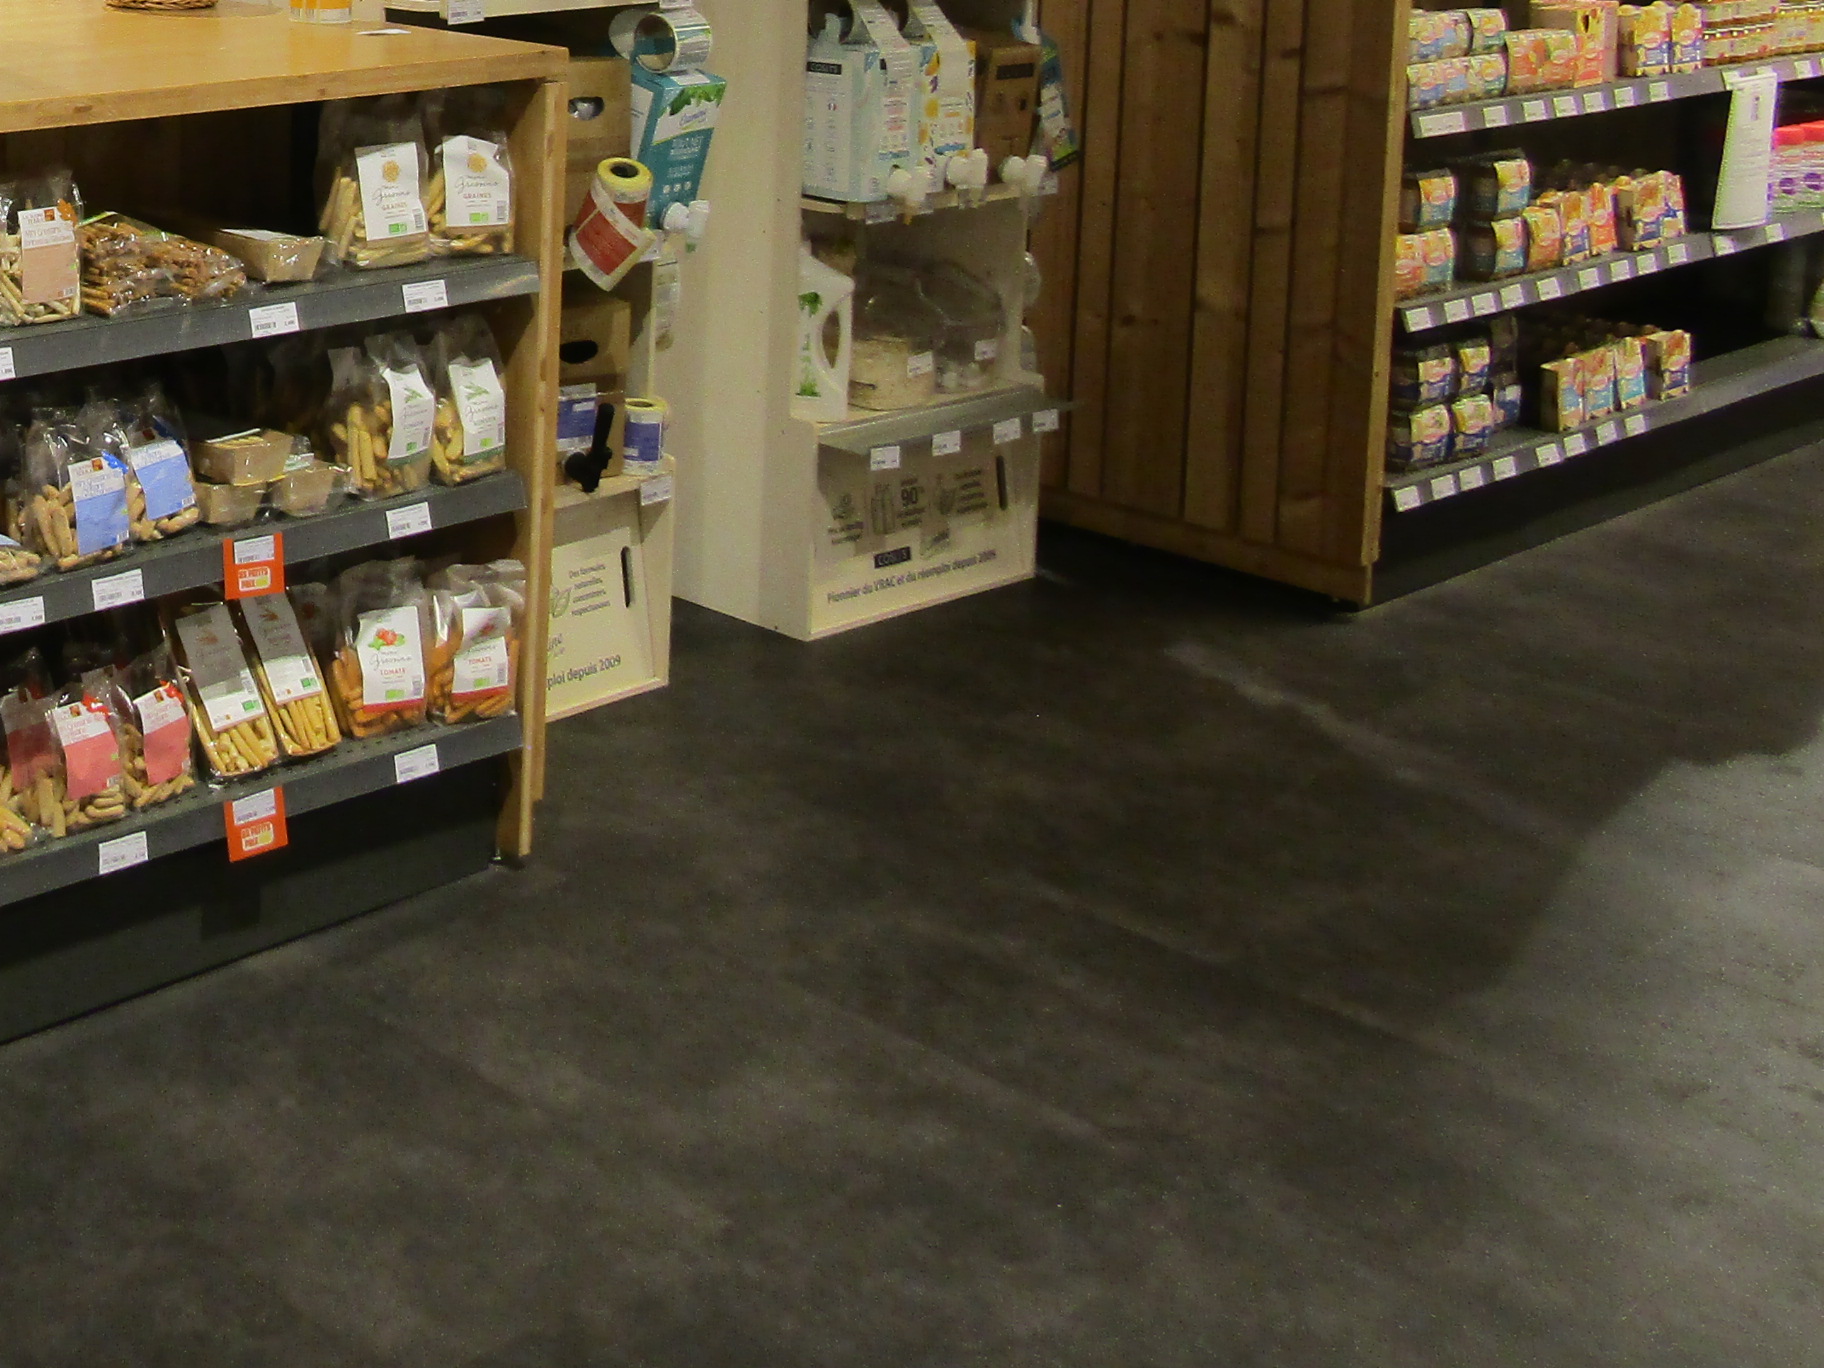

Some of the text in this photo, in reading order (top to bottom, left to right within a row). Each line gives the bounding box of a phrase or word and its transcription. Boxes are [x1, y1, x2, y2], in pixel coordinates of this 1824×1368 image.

[547, 653, 622, 690] ploi depuis 2009
